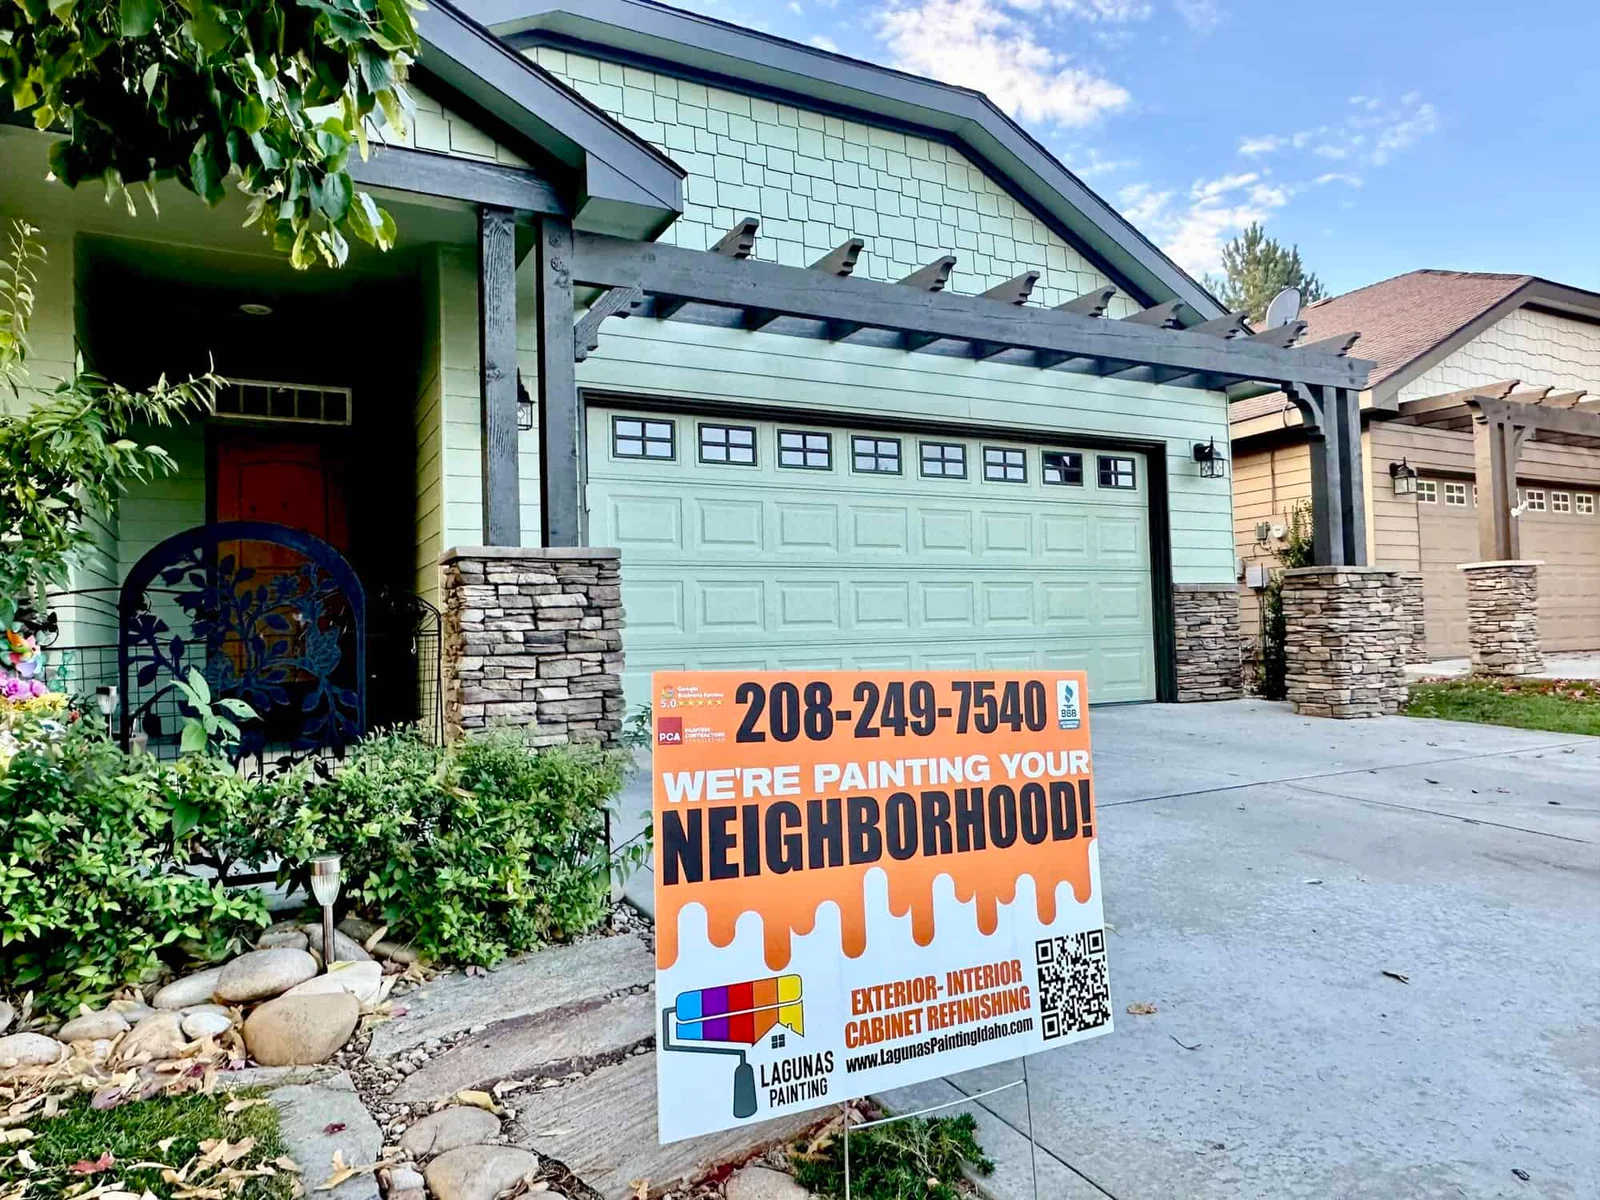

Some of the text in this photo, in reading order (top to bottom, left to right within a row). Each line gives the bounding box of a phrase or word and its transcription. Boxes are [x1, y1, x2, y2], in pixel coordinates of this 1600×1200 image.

[660, 699, 677, 709] 5.0
[735, 680, 1047, 743] 208-249-7540
[1061, 709, 1077, 718] BBB
[659, 732, 680, 742] PCA
[662, 750, 1090, 803] WE'RE PAINTING YOUR
[662, 779, 1093, 886] NEIGHBORHOOD!
[946, 959, 1022, 997] INTERIOR
[844, 985, 1031, 1049] CABINET REFINISHING
[846, 1017, 1033, 1073] www.LagunasPaintingIdaho.com
[760, 1050, 834, 1088] LAGUNAS
[769, 1077, 828, 1108] PAINTING
